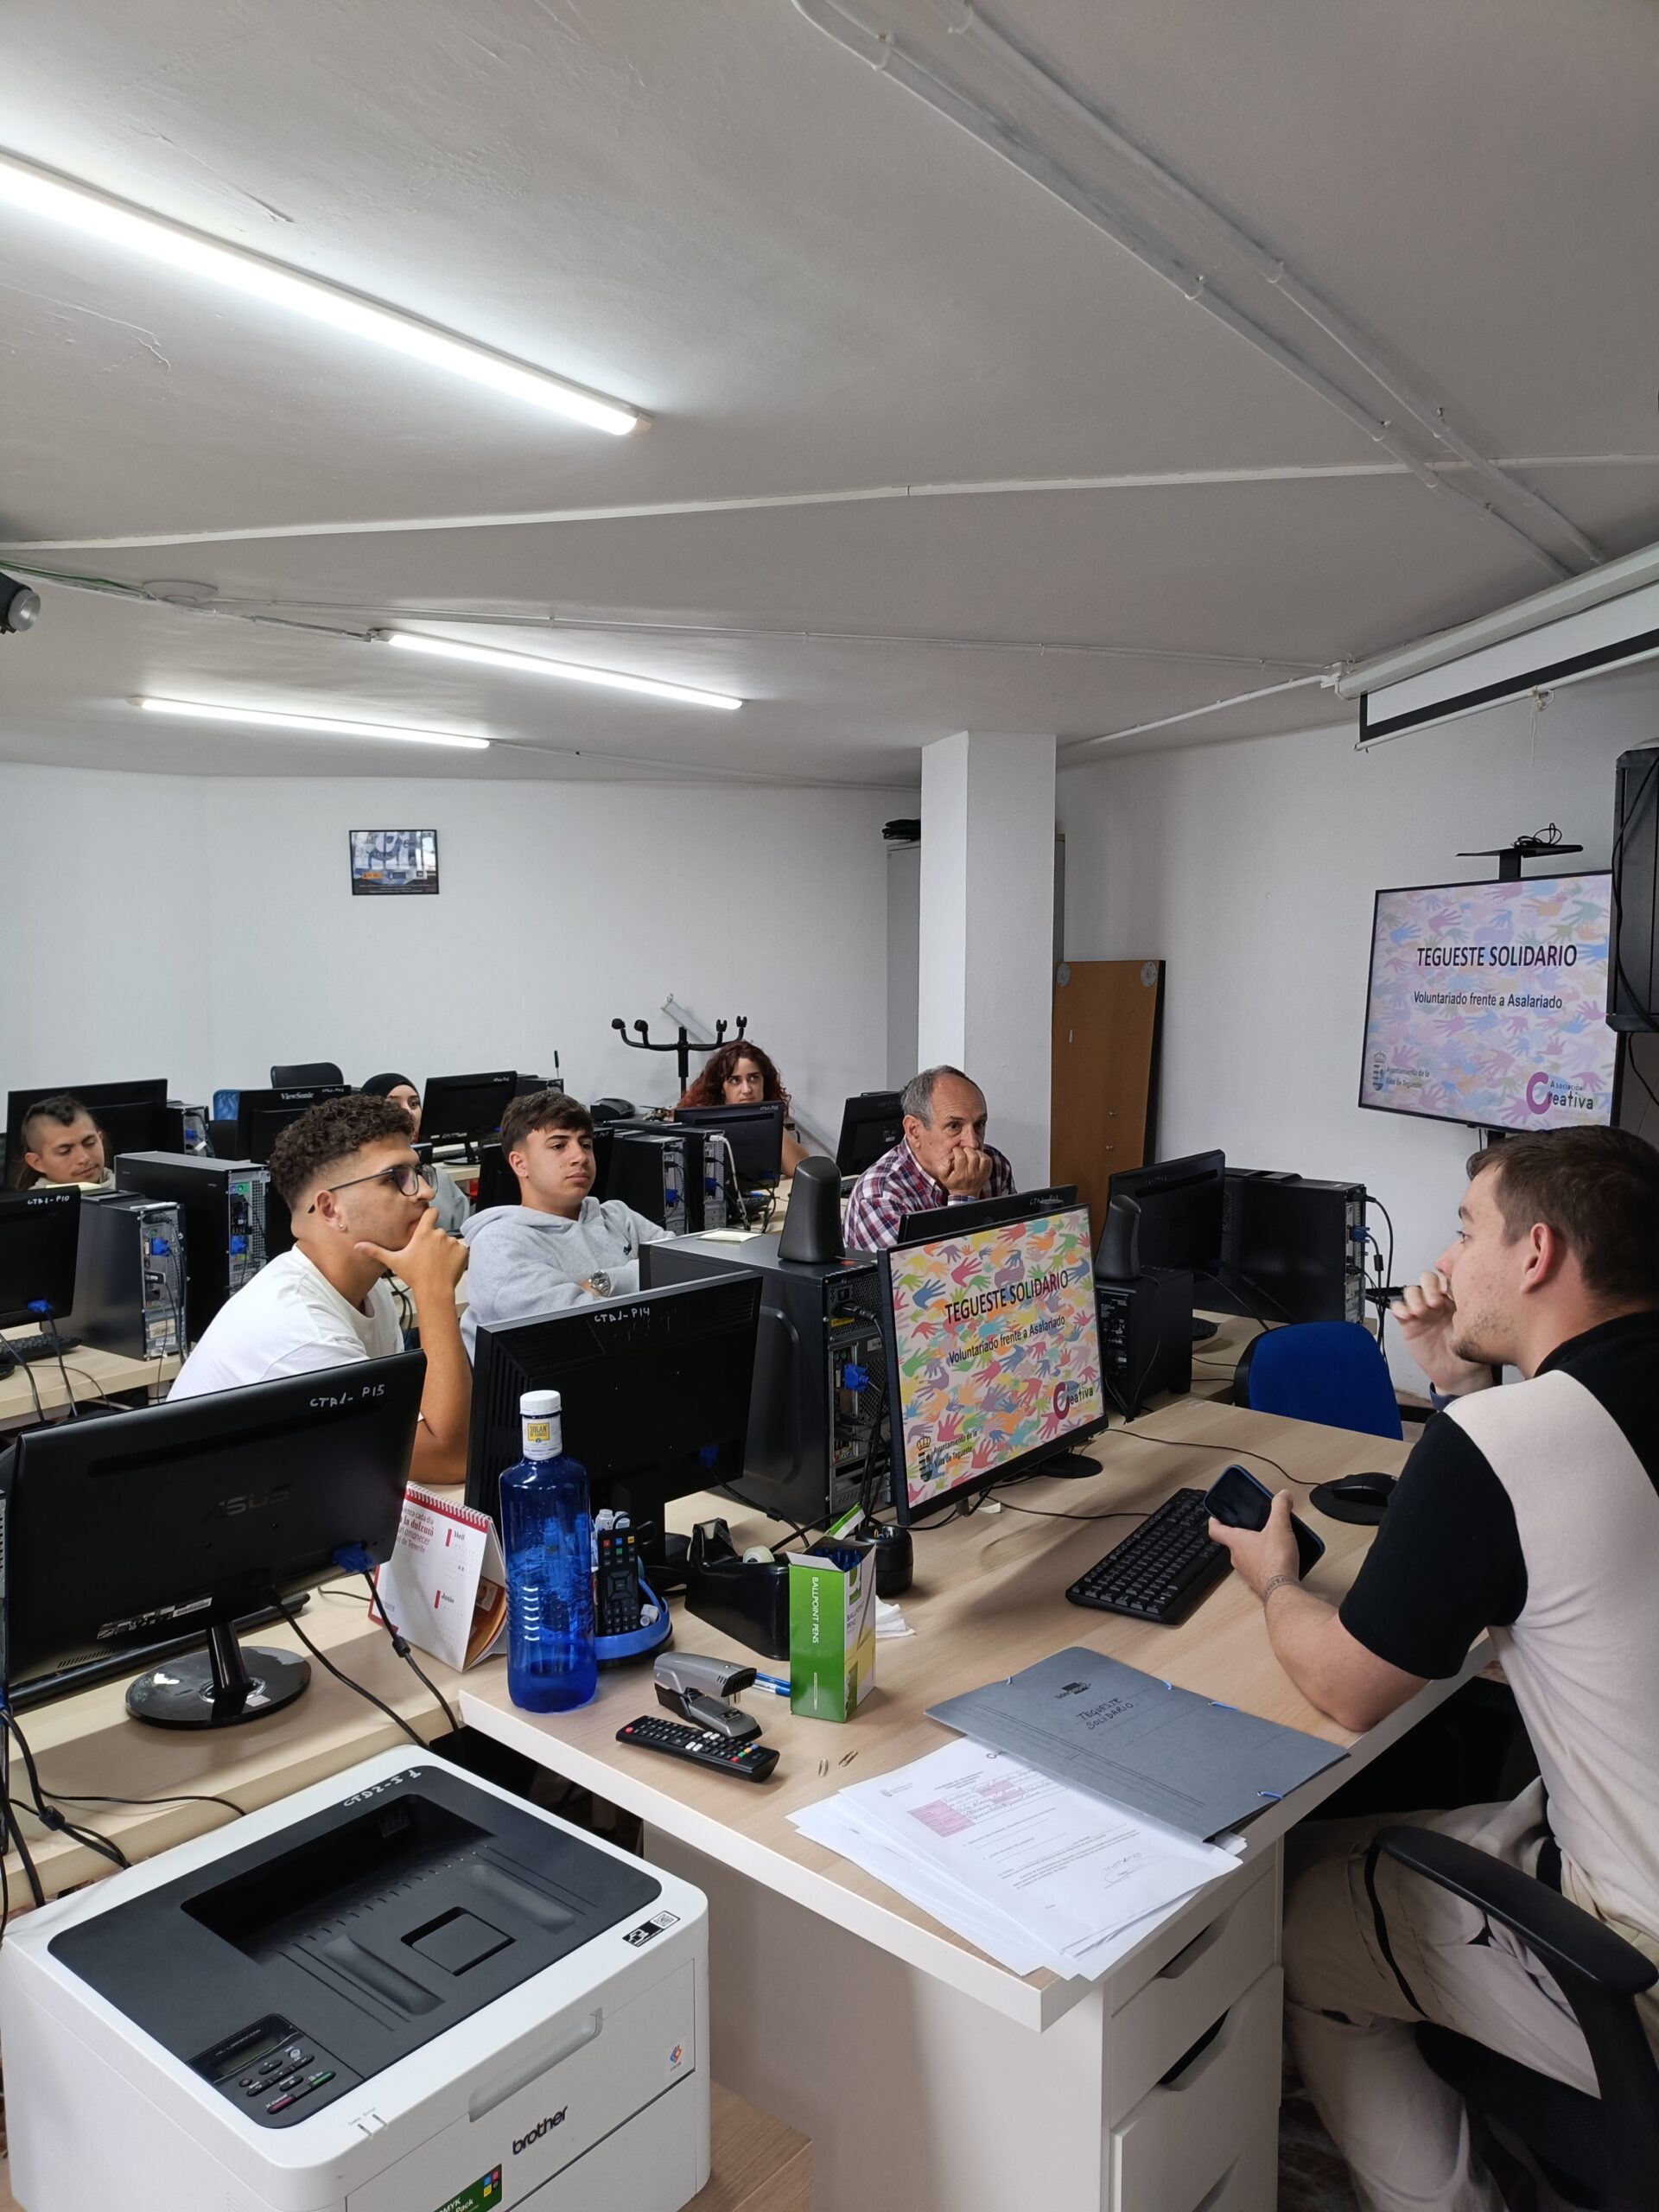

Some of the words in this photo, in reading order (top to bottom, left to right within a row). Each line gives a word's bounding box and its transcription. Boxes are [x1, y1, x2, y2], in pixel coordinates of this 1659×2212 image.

[1417, 946, 1485, 967] TEGUESTE
[1489, 944, 1578, 967] SOLIDARIO
[1414, 991, 1467, 1006] Voluntariado
[1470, 993, 1497, 1006] frente
[1499, 996, 1505, 1007] a
[1507, 994, 1563, 1009] Asalariado
[281, 1091, 315, 1100] ViewSonic
[944, 1287, 1007, 1324] TEGUESTE
[1009, 1270, 1069, 1305] SOLIDARIO
[948, 1339, 999, 1364] Voluntariado
[1000, 1332, 1021, 1347] frente
[1023, 1329, 1028, 1338] a
[1029, 1314, 1065, 1337] Asalariado
[362, 1384, 385, 1397] P15
[933, 1434, 966, 1455] Ayuntamiento
[966, 1431, 972, 1440] de
[972, 1429, 977, 1438] la
[952, 1446, 973, 1460] Tegueste
[404, 1529, 430, 1546] amanecer
[441, 1592, 454, 1604] Junio
[1085, 1702, 1134, 1730] SOLIDARIO
[512, 2105, 569, 2155] brother
